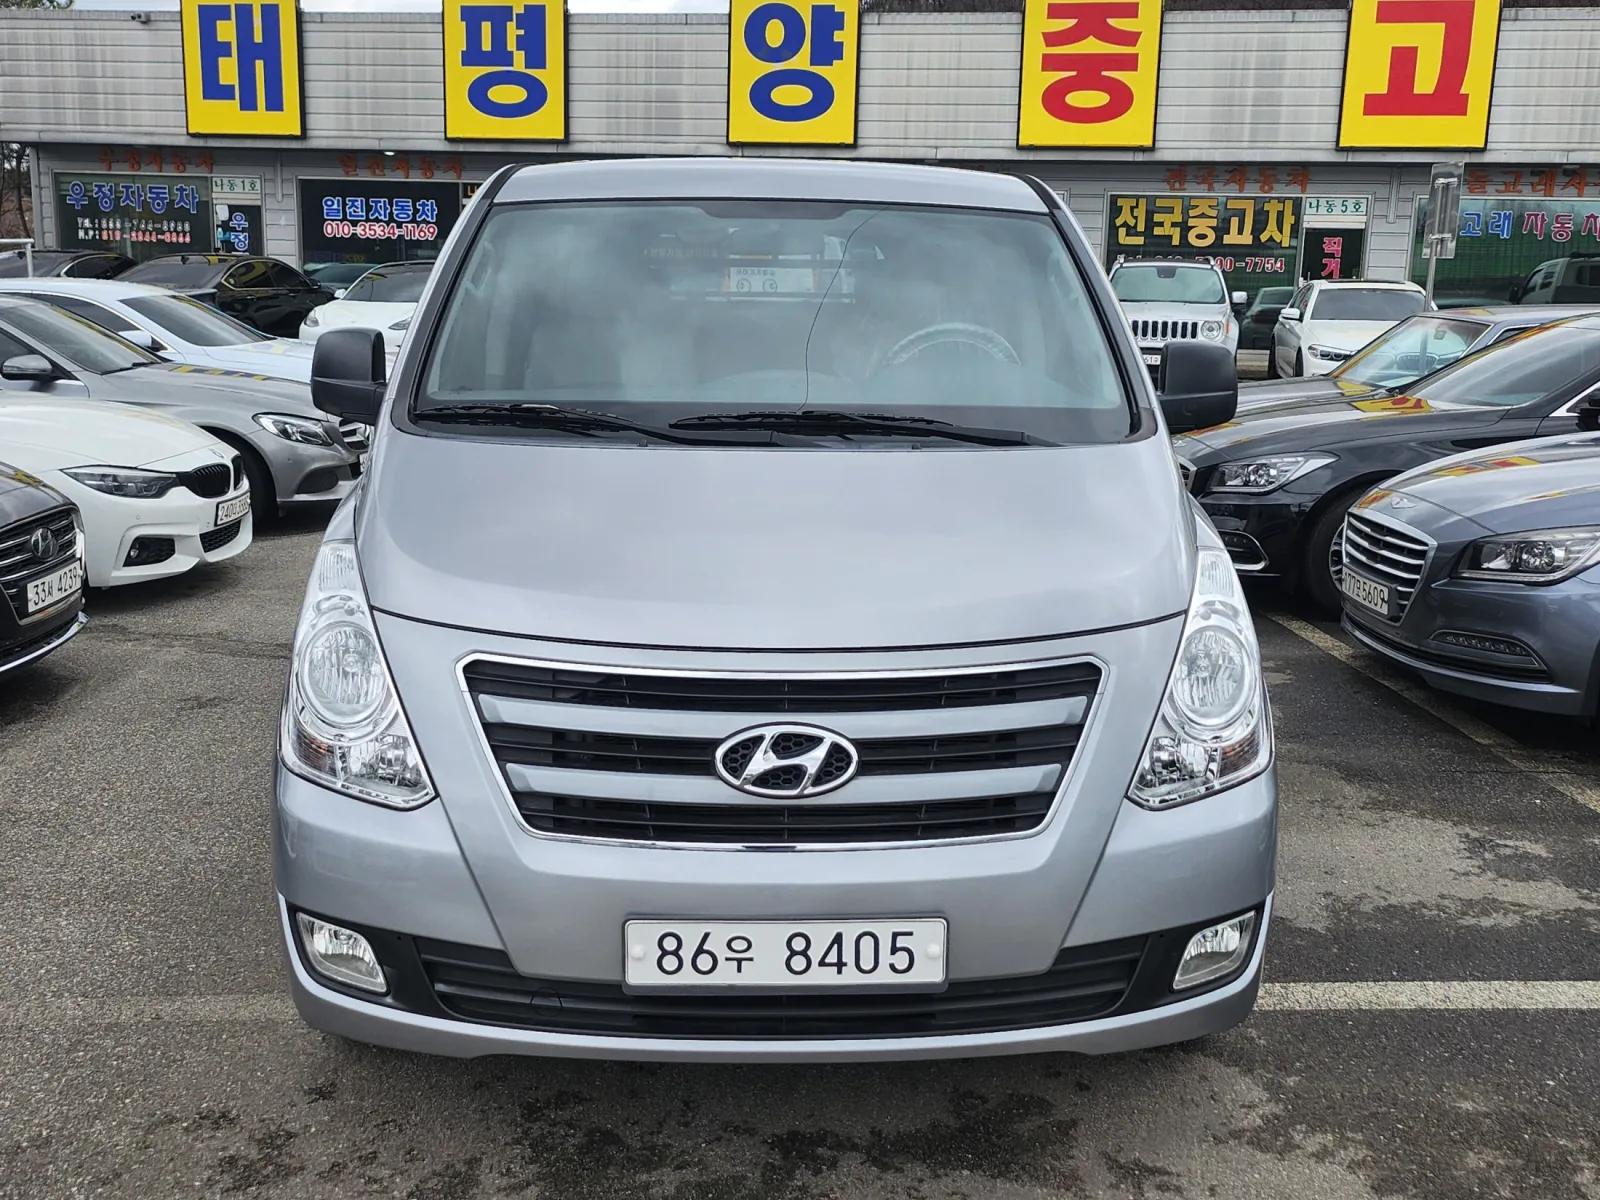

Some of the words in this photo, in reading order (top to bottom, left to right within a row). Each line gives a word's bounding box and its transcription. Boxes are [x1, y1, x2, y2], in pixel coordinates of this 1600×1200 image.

[197, 3, 285, 113] 태
[460, 4, 548, 119] 평
[743, 2, 846, 122] 양
[1041, 0, 1143, 125] 중
[1363, 0, 1476, 116] 고
[66, 181, 200, 214] 우정자동차
[322, 196, 438, 222] 일진자동차
[323, 220, 438, 240] 010-3534-1169
[1114, 197, 1295, 248] 전국중고차
[57, 566, 78, 594] 4239
[655, 931, 755, 976] 86우
[784, 930, 916, 976] 8405
